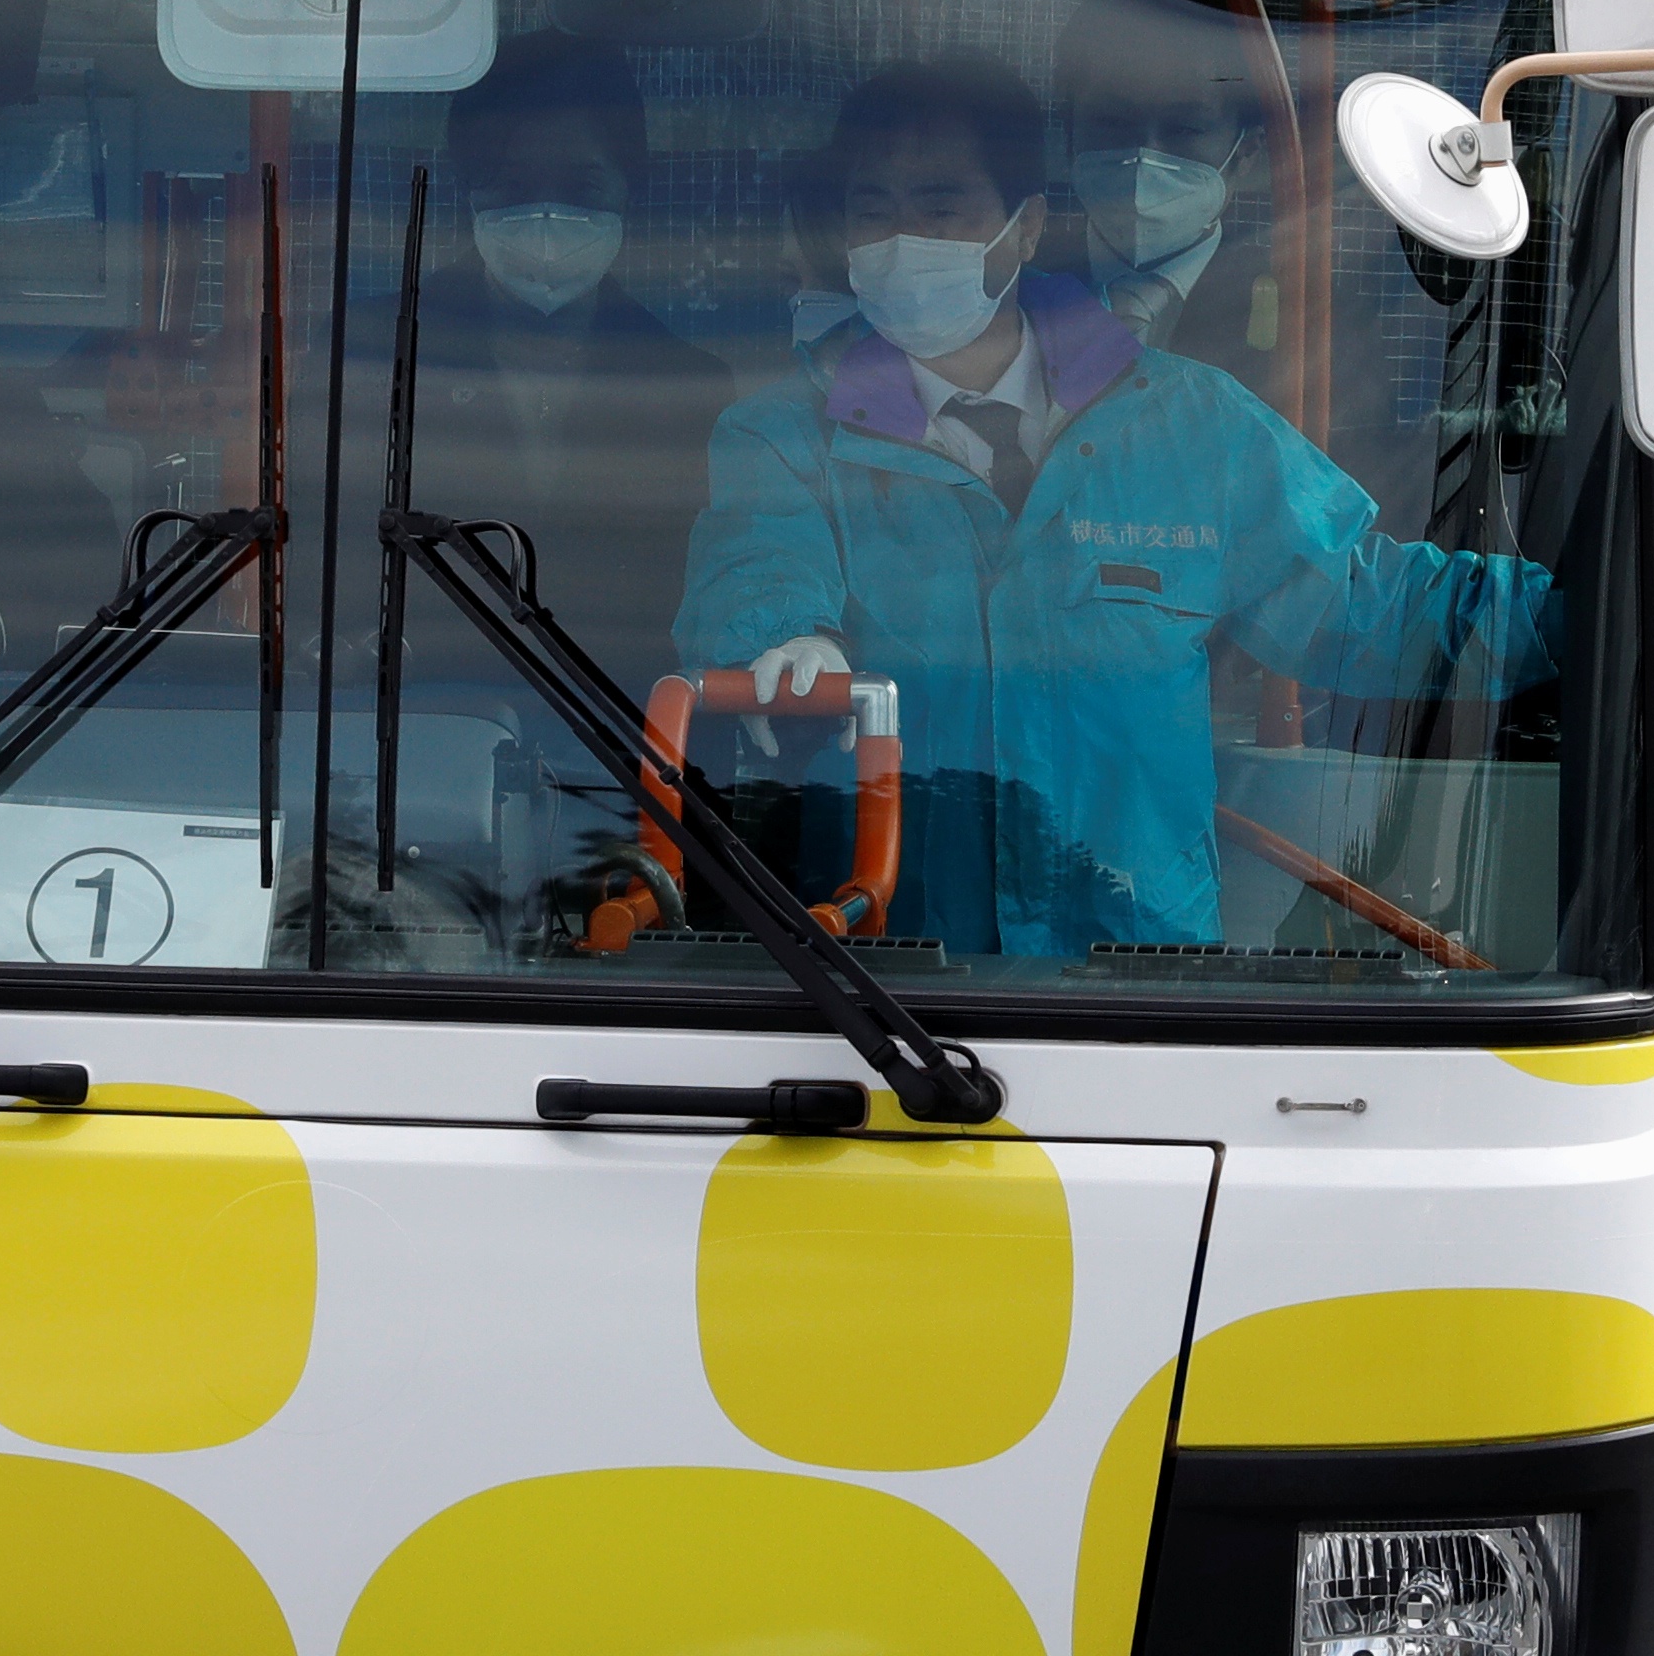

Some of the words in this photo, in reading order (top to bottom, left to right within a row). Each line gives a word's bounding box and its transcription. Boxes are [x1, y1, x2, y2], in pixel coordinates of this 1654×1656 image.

[1070, 519, 1219, 549] 横浜市交通局
